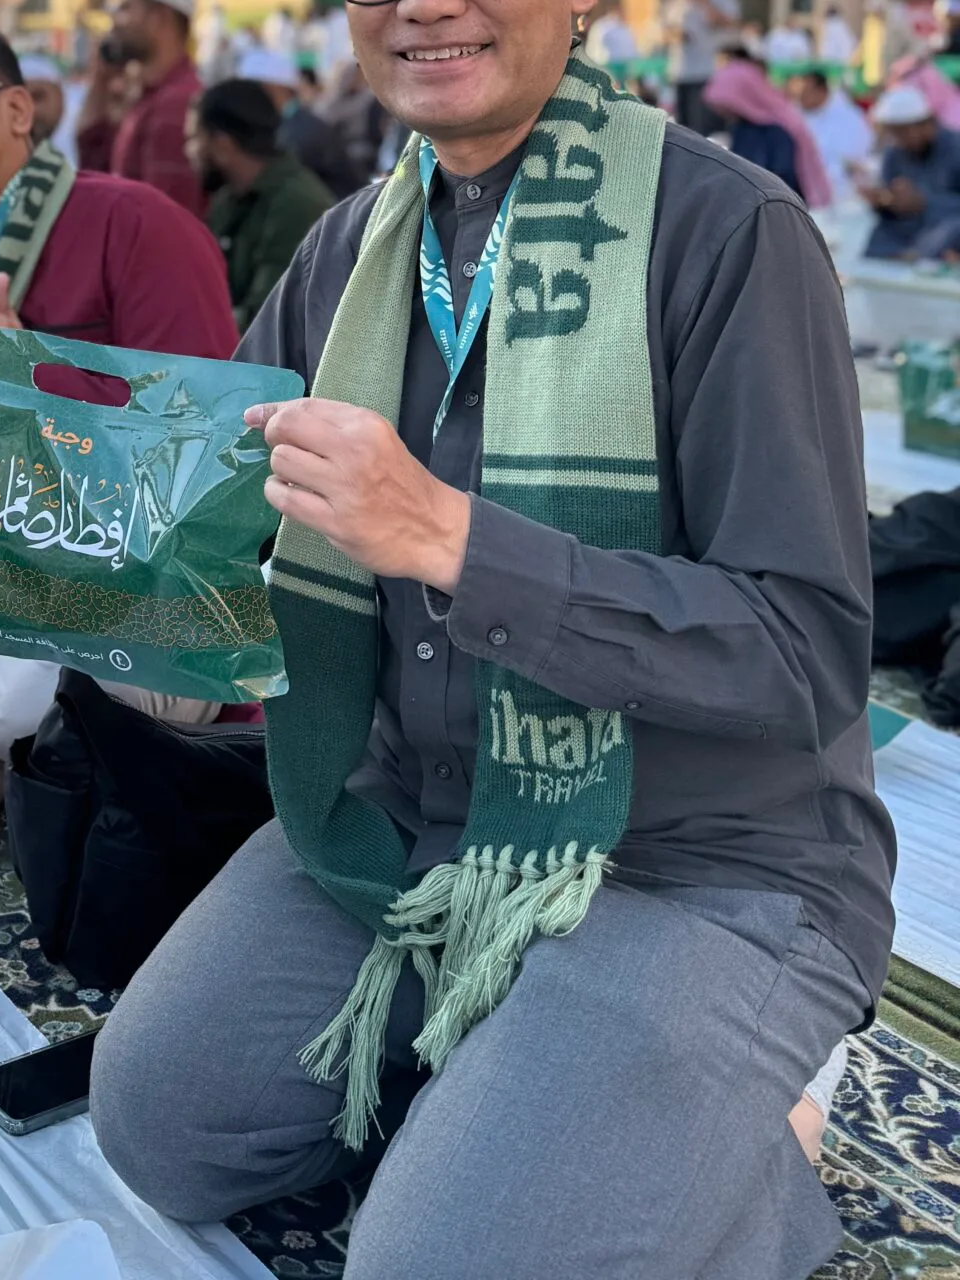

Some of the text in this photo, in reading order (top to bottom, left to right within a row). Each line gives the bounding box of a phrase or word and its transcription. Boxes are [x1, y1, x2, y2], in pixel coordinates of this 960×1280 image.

[504, 57, 642, 349] hata
[40, 417, 94, 455] وجبة
[4, 632, 34, 644] المسجد
